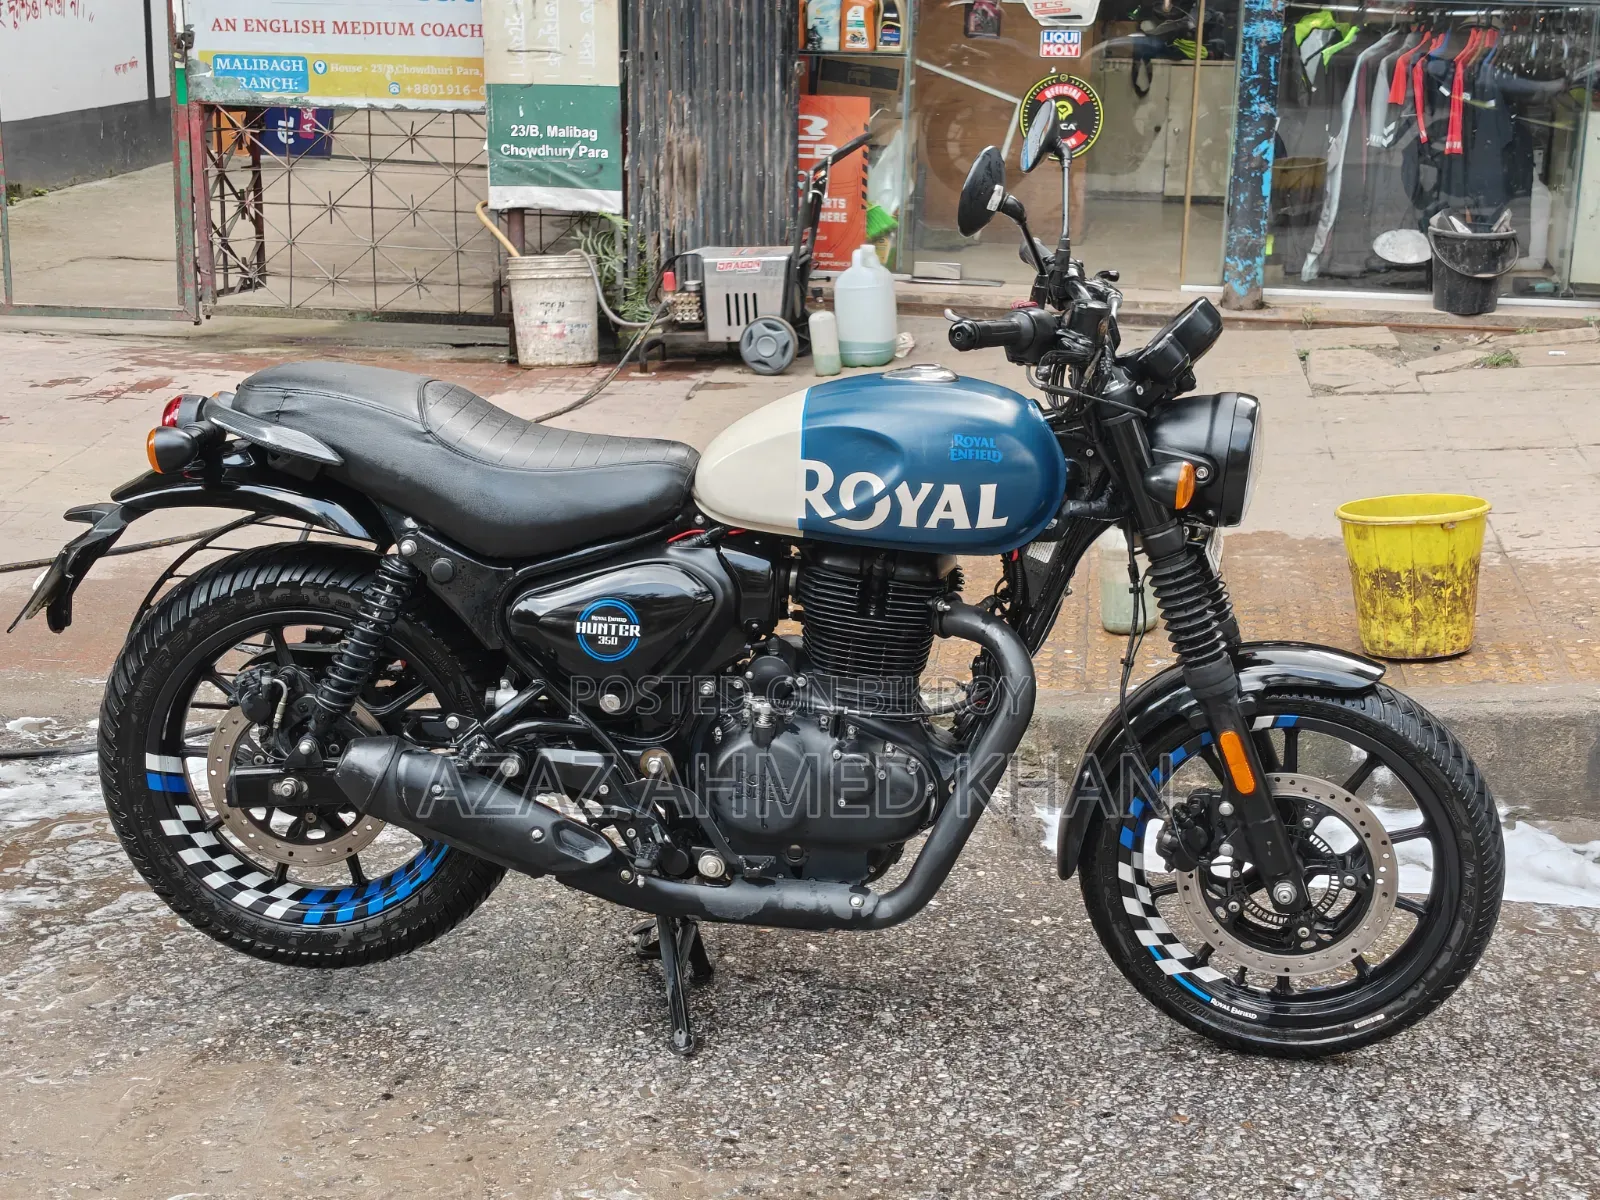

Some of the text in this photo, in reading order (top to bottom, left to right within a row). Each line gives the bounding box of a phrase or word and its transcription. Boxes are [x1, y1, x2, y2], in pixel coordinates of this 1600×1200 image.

[211, 18, 483, 38] AN ENGLISH MEDIUM COACH
[1043, 31, 1079, 44] LIQUI
[1042, 44, 1079, 56] MOLY
[216, 58, 305, 72] MALIBAGH
[331, 62, 362, 73] House
[456, 65, 483, 77] Para,
[238, 76, 299, 90] RANCH:
[1044, 85, 1082, 100] OFFICIAL
[510, 124, 598, 141] 23/B, Malibag
[500, 143, 609, 161] Chowdhury Para
[717, 260, 762, 271] DRAGON
[952, 433, 998, 449] ROYAL
[949, 448, 1003, 463] ENFIELD
[798, 458, 1009, 531] ROYAL
[575, 621, 641, 637] HUNTER
[597, 635, 618, 646] 350
[1210, 997, 1258, 1020] ROYAL ENFIELD
